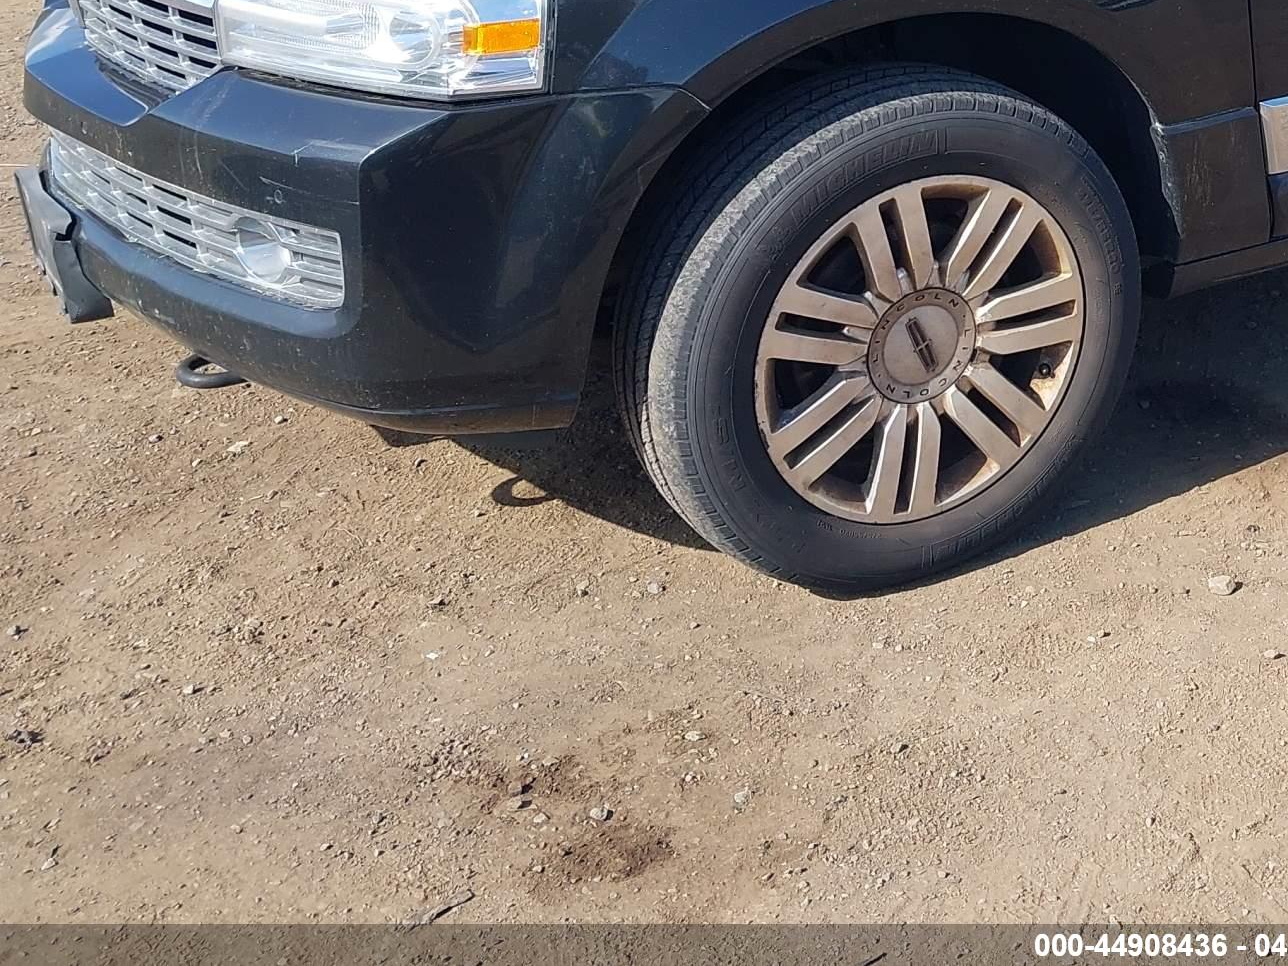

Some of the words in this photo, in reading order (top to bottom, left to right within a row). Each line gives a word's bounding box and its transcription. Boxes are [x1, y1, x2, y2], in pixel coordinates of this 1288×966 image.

[791, 129, 938, 226] MICHELIN
[873, 293, 959, 363] LINCOLN
[886, 328, 971, 399] LINCOLN
